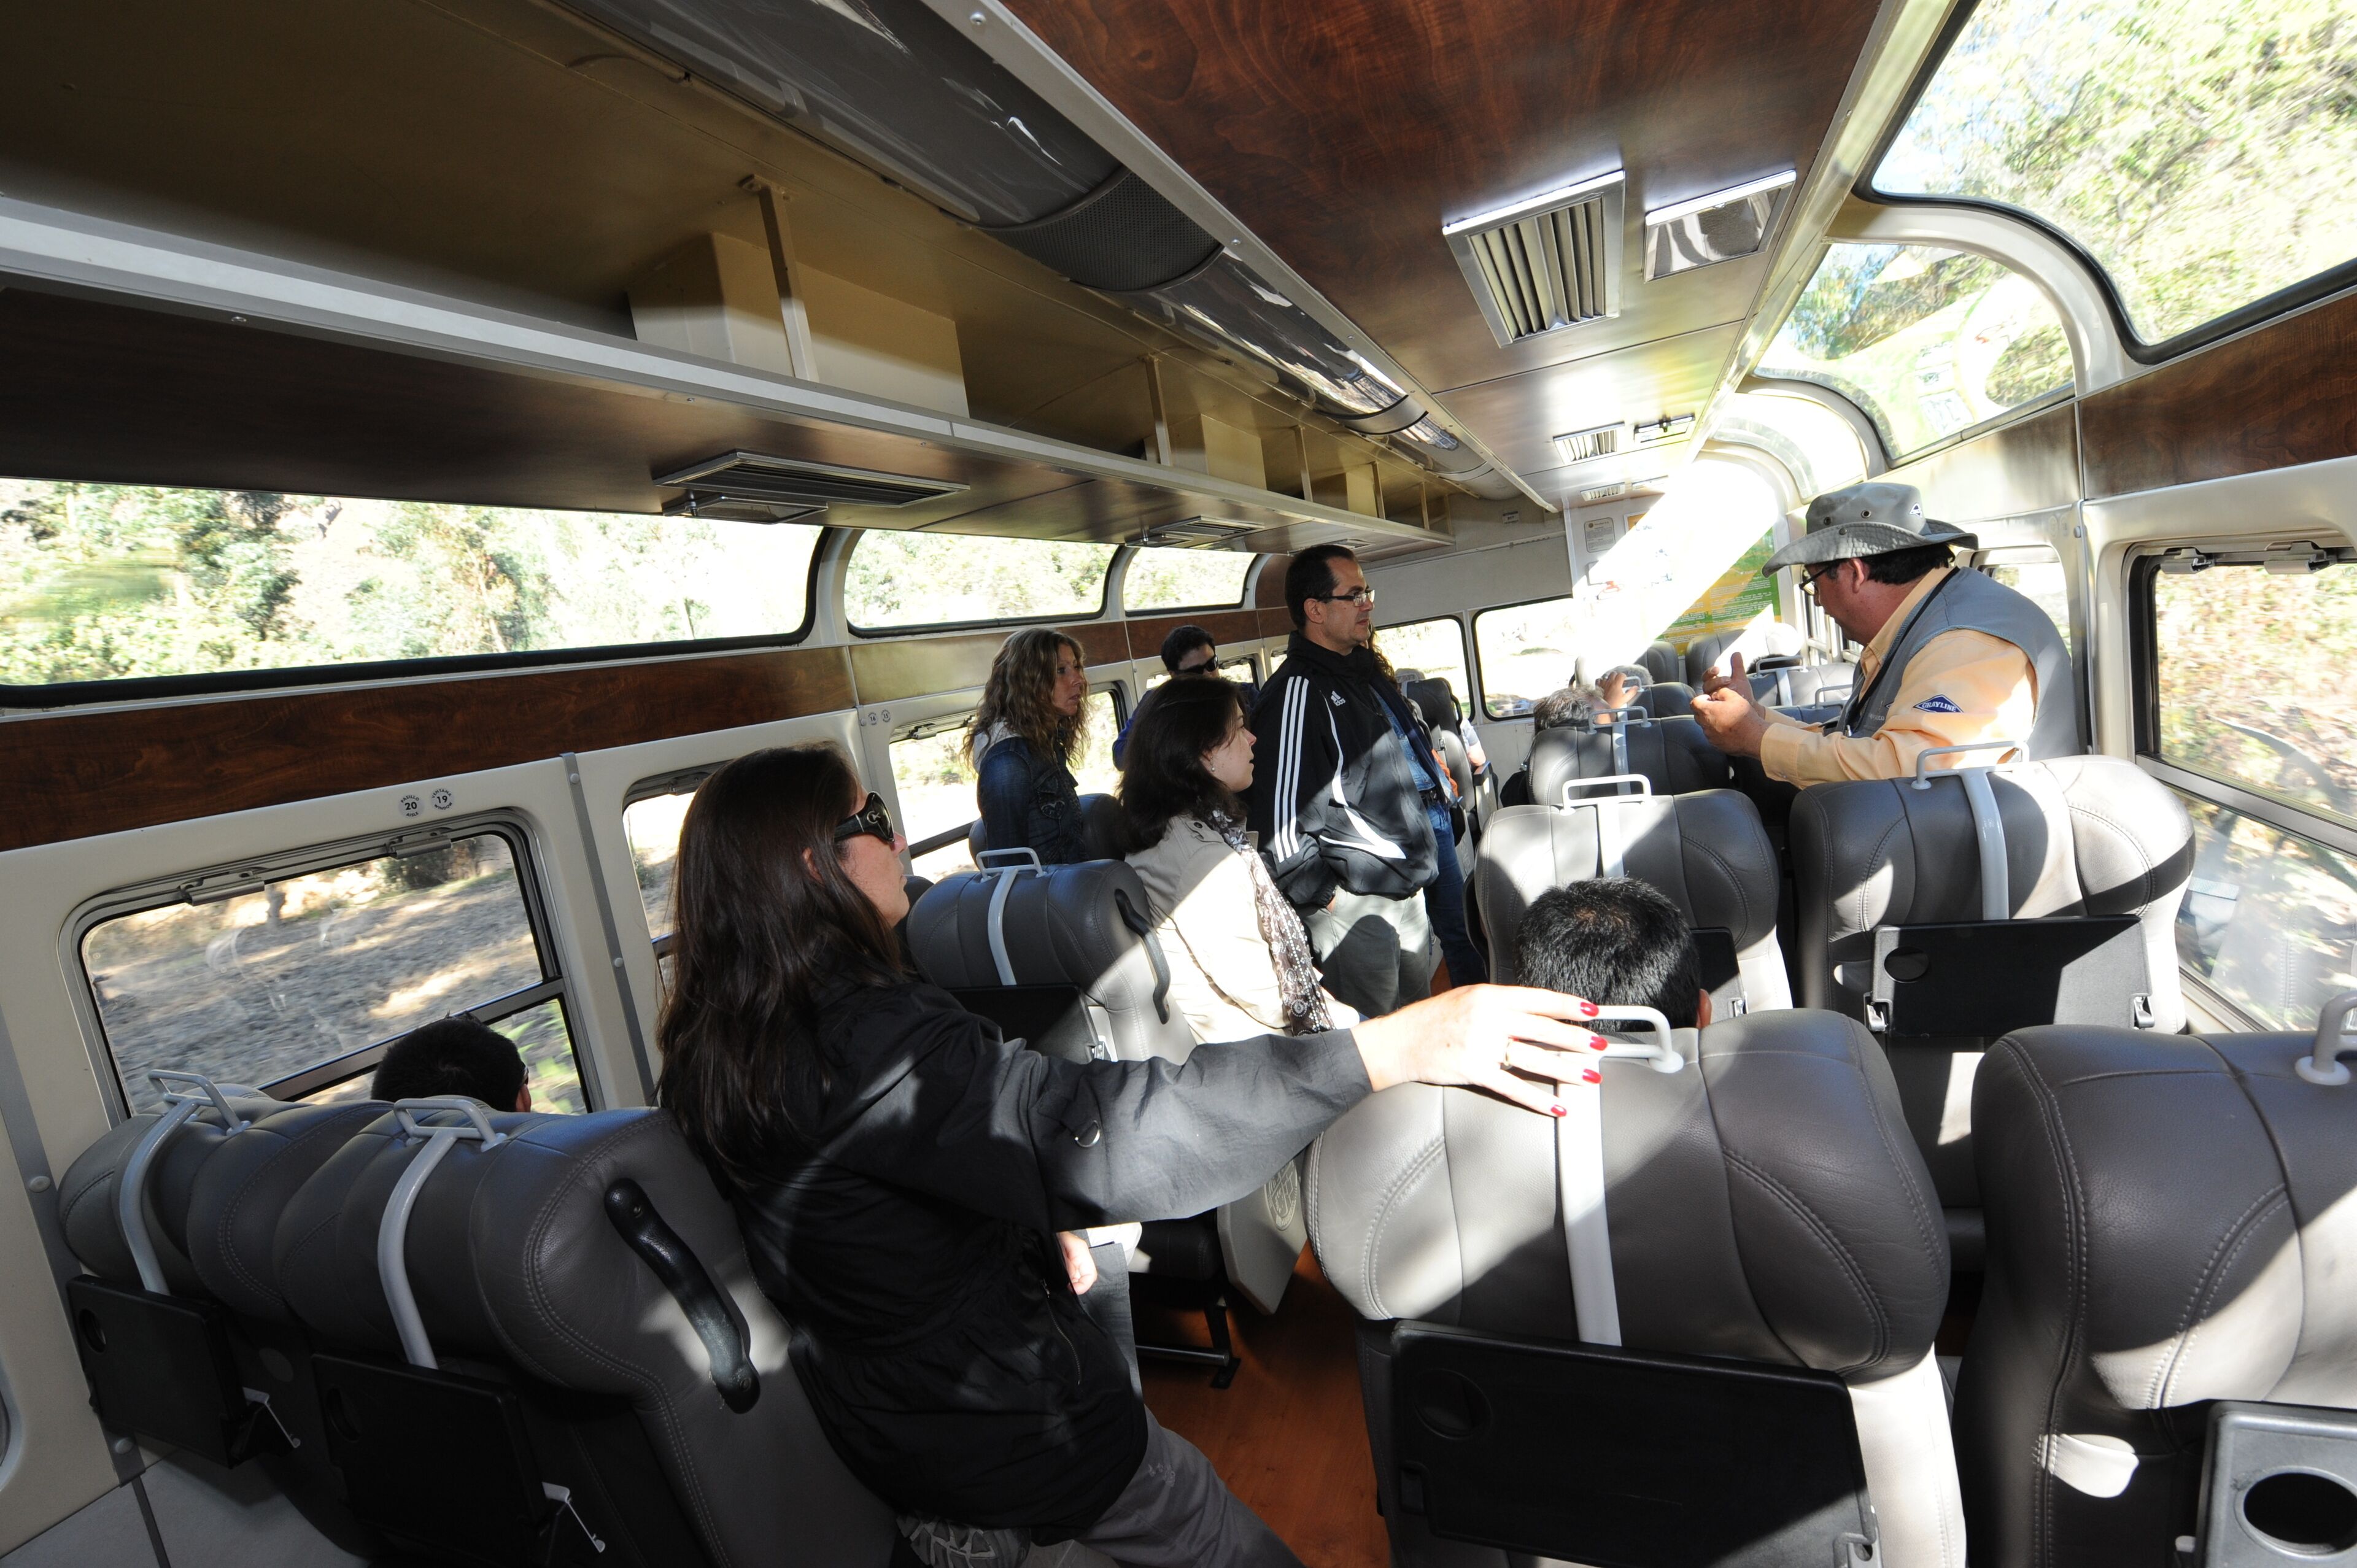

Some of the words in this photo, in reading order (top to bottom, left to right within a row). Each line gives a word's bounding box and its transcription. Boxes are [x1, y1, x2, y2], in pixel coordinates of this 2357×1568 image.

[432, 789, 452, 798] VENTANA
[400, 795, 420, 803] PASILLO
[436, 795, 448, 804] 19
[404, 801, 417, 810] 20
[434, 801, 452, 810] WINDOW
